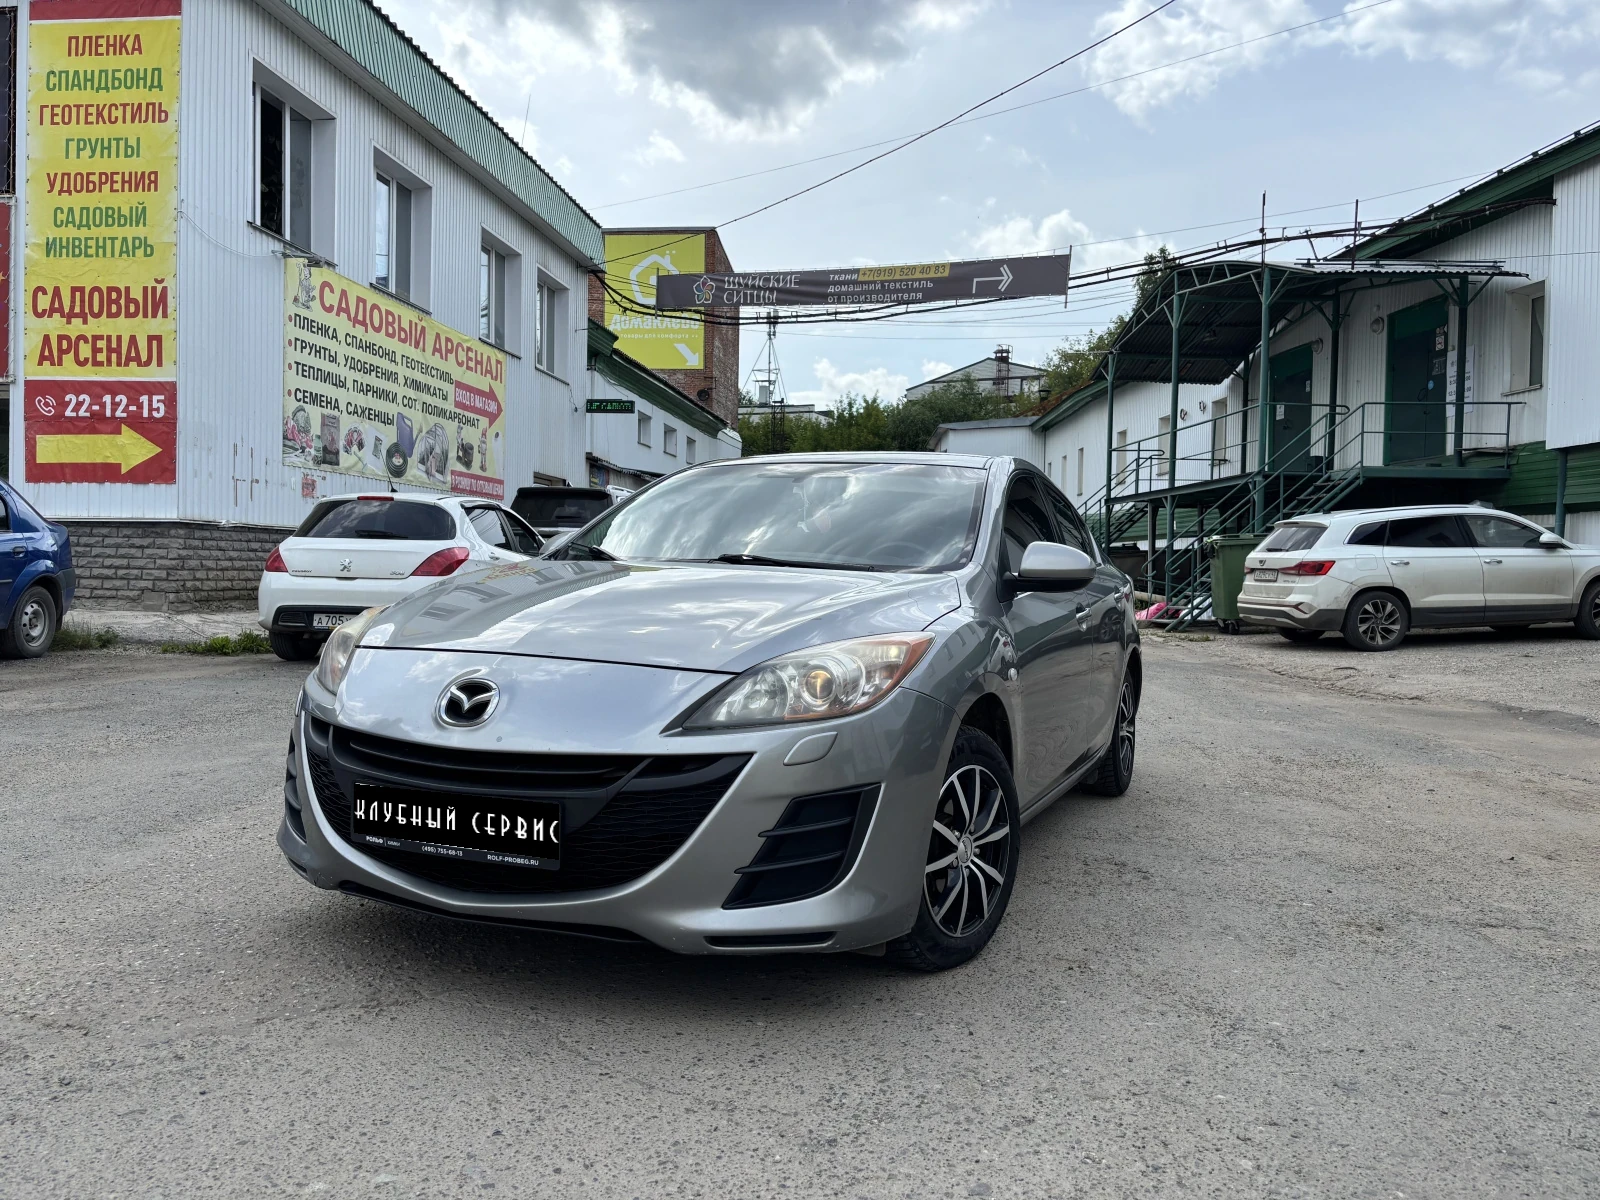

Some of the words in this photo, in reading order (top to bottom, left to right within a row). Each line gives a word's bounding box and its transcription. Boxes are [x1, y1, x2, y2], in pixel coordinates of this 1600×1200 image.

[67, 34, 143, 57] ПЛЕНКА
[46, 67, 163, 93] СПАНДБОНД
[39, 101, 169, 126] ГЕОТЕКСТИЛЬ
[64, 136, 141, 159] ГРУНТЫ
[46, 170, 159, 196] УДОБРЕНИЯ
[53, 201, 147, 230] САДОВЫЙ
[45, 236, 155, 258] ИНВЕНТАРЬ
[724, 273, 800, 289] ШУЙСКИЕ
[829, 272, 858, 281] ткани
[861, 268, 897, 280] +7(919)
[899, 266, 917, 277] 520
[919, 265, 932, 276] 40
[933, 264, 946, 275] 83
[723, 290, 777, 305] СИТЦЫ
[827, 281, 882, 293] домашний
[883, 280, 934, 290] текстиль
[827, 295, 839, 303] от
[840, 291, 923, 304] производителя
[31, 278, 169, 325] САДОВЫЙ
[318, 280, 426, 353] САДОВЫЙ
[431, 332, 503, 384] АРСЕНАЛ
[37, 334, 163, 368] АРСЕНАЛ
[294, 313, 341, 345] ПЛЕНКА,
[345, 333, 399, 366] СПАНБОНД,
[401, 354, 454, 385] ГЕОТЕКСТИЛЬ
[294, 337, 340, 367] ГРУНТЫ,
[343, 354, 400, 387] УДОБРЕНИЯ,
[403, 375, 448, 402] ХИМИКАТЫ
[64, 393, 165, 418] 22-12-15
[294, 361, 350, 392] ТЕПЛИЦЫ,
[353, 379, 400, 407] ПАРНИКИ,
[421, 401, 480, 429] ПОЛИКАРБОНАТ
[294, 387, 343, 415] СЕМЕНА,
[345, 401, 395, 426] САЖЕНЦЫ
[455, 387, 470, 406] ВХОД
[470, 393, 475, 406] В
[475, 394, 498, 414] МАГАЗИН
[487, 854, 539, 866] ROLF-PROBEG.RU
